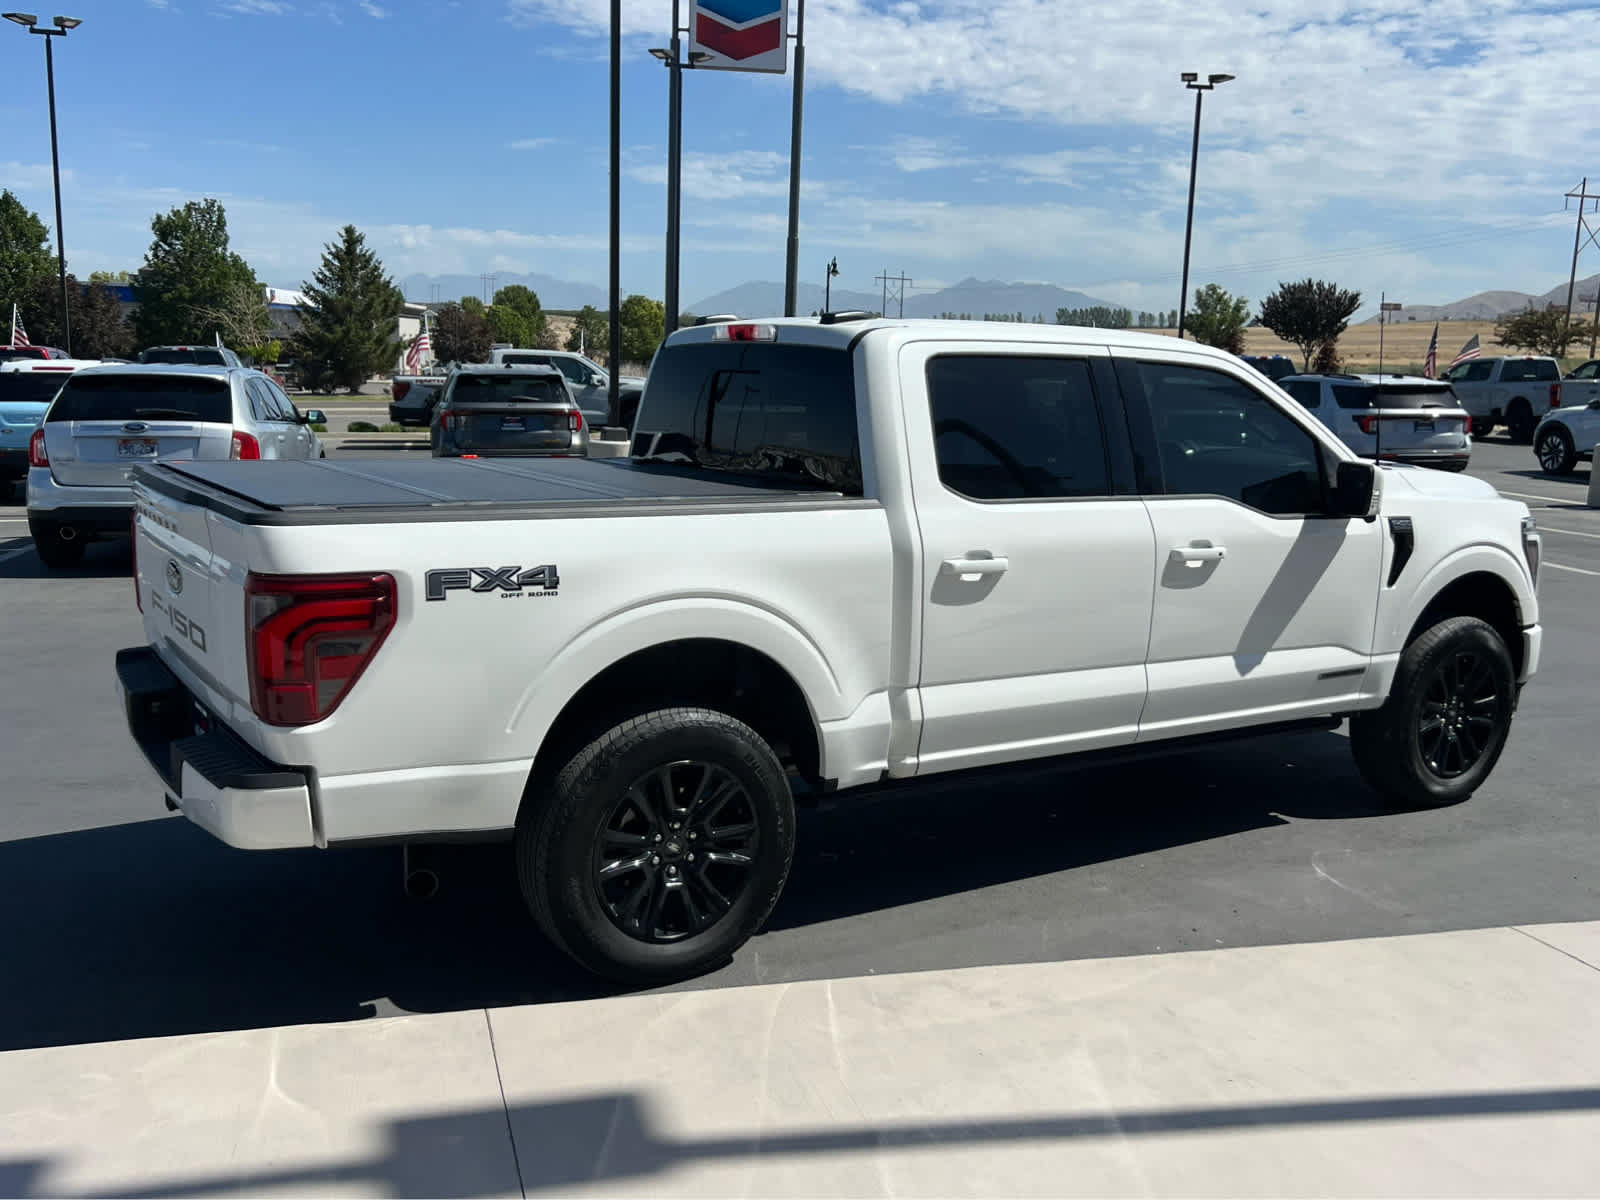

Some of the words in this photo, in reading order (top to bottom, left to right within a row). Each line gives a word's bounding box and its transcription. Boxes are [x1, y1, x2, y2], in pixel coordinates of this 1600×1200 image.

[424, 564, 560, 602] FX4
[528, 590, 559, 598] ROAD
[151, 589, 207, 653] F-150
